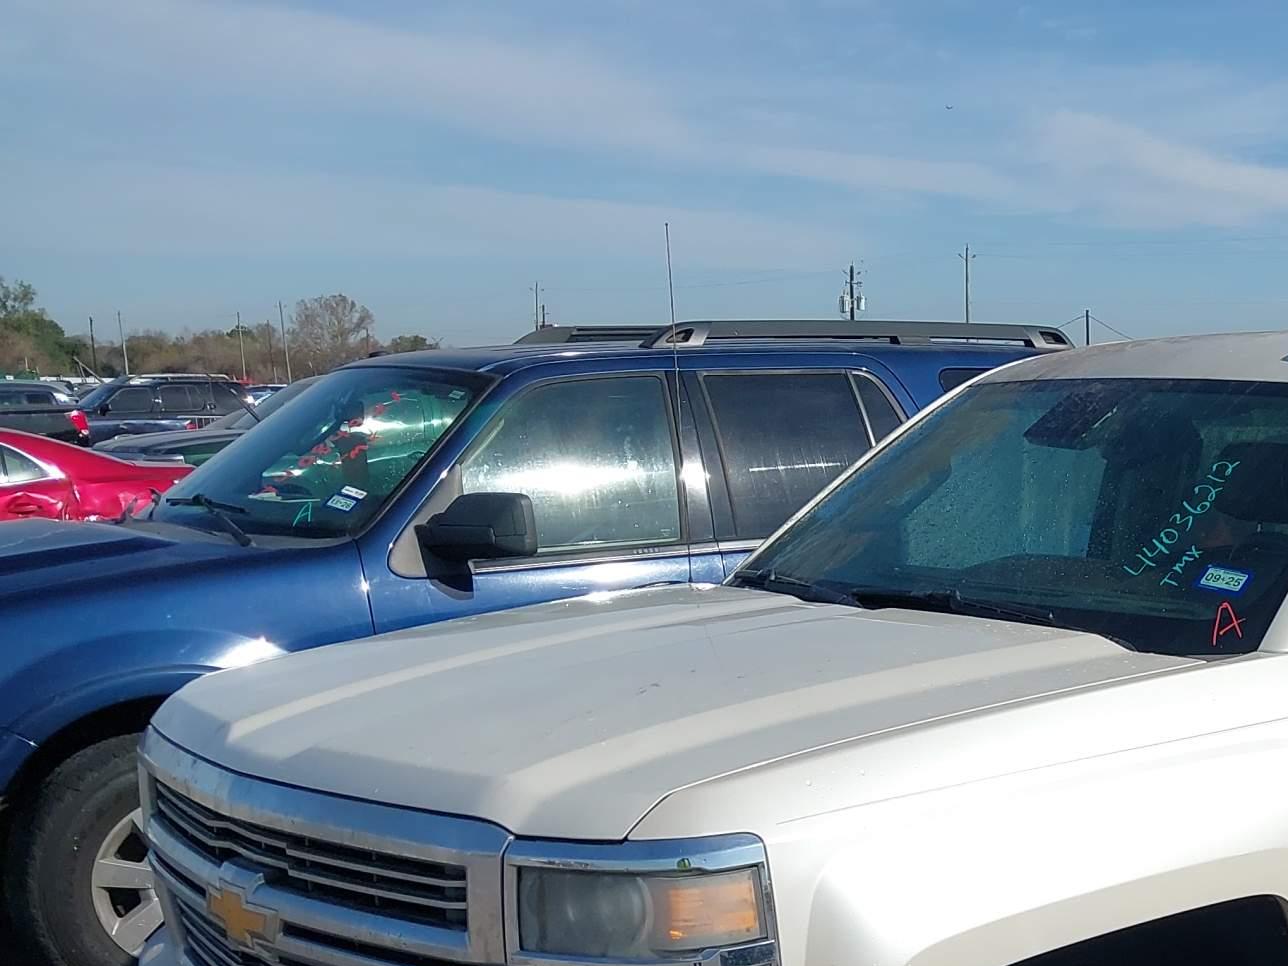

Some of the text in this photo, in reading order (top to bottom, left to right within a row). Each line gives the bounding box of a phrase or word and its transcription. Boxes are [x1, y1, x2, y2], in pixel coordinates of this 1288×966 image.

[293, 501, 312, 527] A
[1123, 460, 1241, 577] 44036212
[1210, 600, 1247, 647] A
